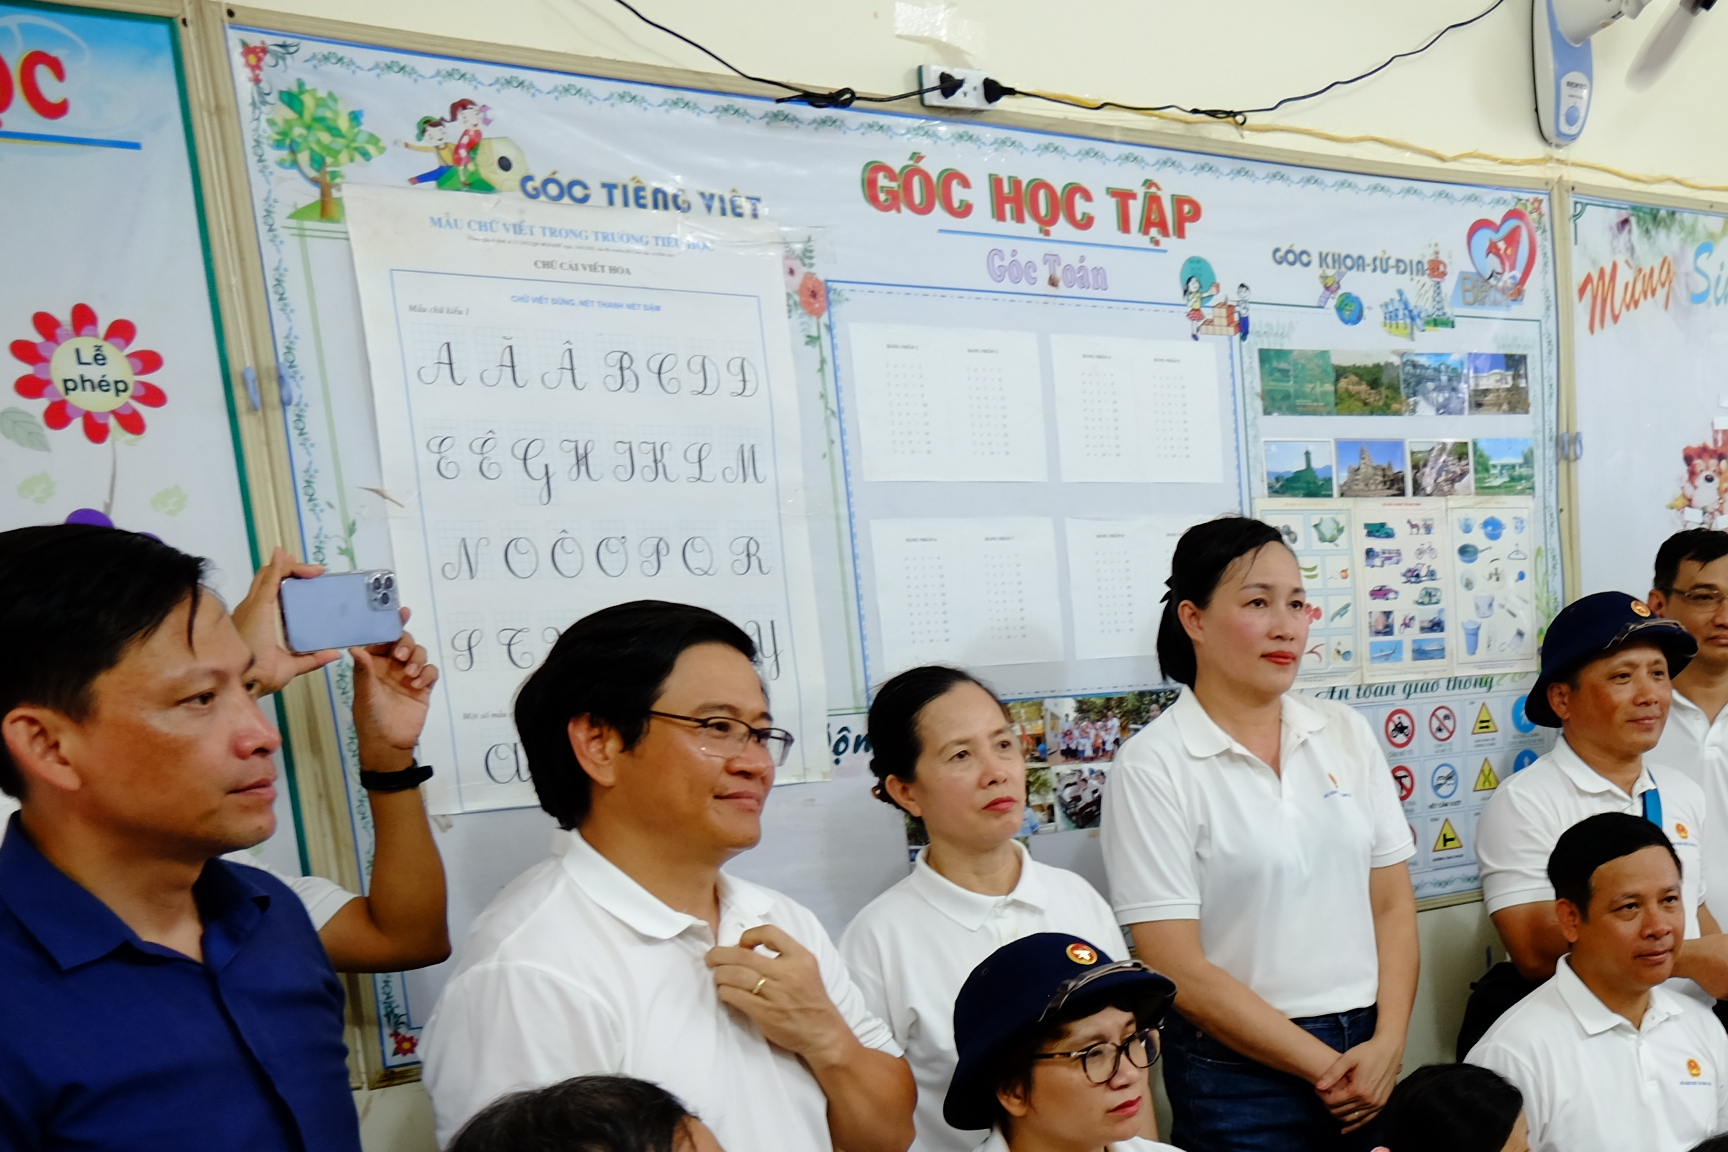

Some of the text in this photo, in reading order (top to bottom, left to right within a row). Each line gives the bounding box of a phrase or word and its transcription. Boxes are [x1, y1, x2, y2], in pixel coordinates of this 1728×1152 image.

[520, 170, 591, 205] GÓC
[861, 151, 1202, 247] GÓC HỌC TẬP
[429, 212, 464, 230] MẪU
[540, 226, 589, 241] TRONG
[986, 248, 1109, 292] Góc Toán
[1272, 243, 1312, 268] GÓC
[1578, 255, 1675, 336] Mừng
[63, 374, 129, 397] phép
[416, 340, 467, 386] A
[479, 335, 529, 389] Ă
[541, 340, 589, 392] Â
[603, 350, 641, 394] B
[646, 353, 682, 395] C
[687, 354, 721, 396] D
[426, 435, 461, 480] E
[559, 439, 602, 483] H
[639, 440, 680, 483] K
[682, 441, 716, 483] L
[721, 442, 767, 484] M
[441, 536, 491, 580] N
[551, 529, 585, 579] Ô
[729, 535, 772, 576] R
[827, 723, 872, 766] ộn
